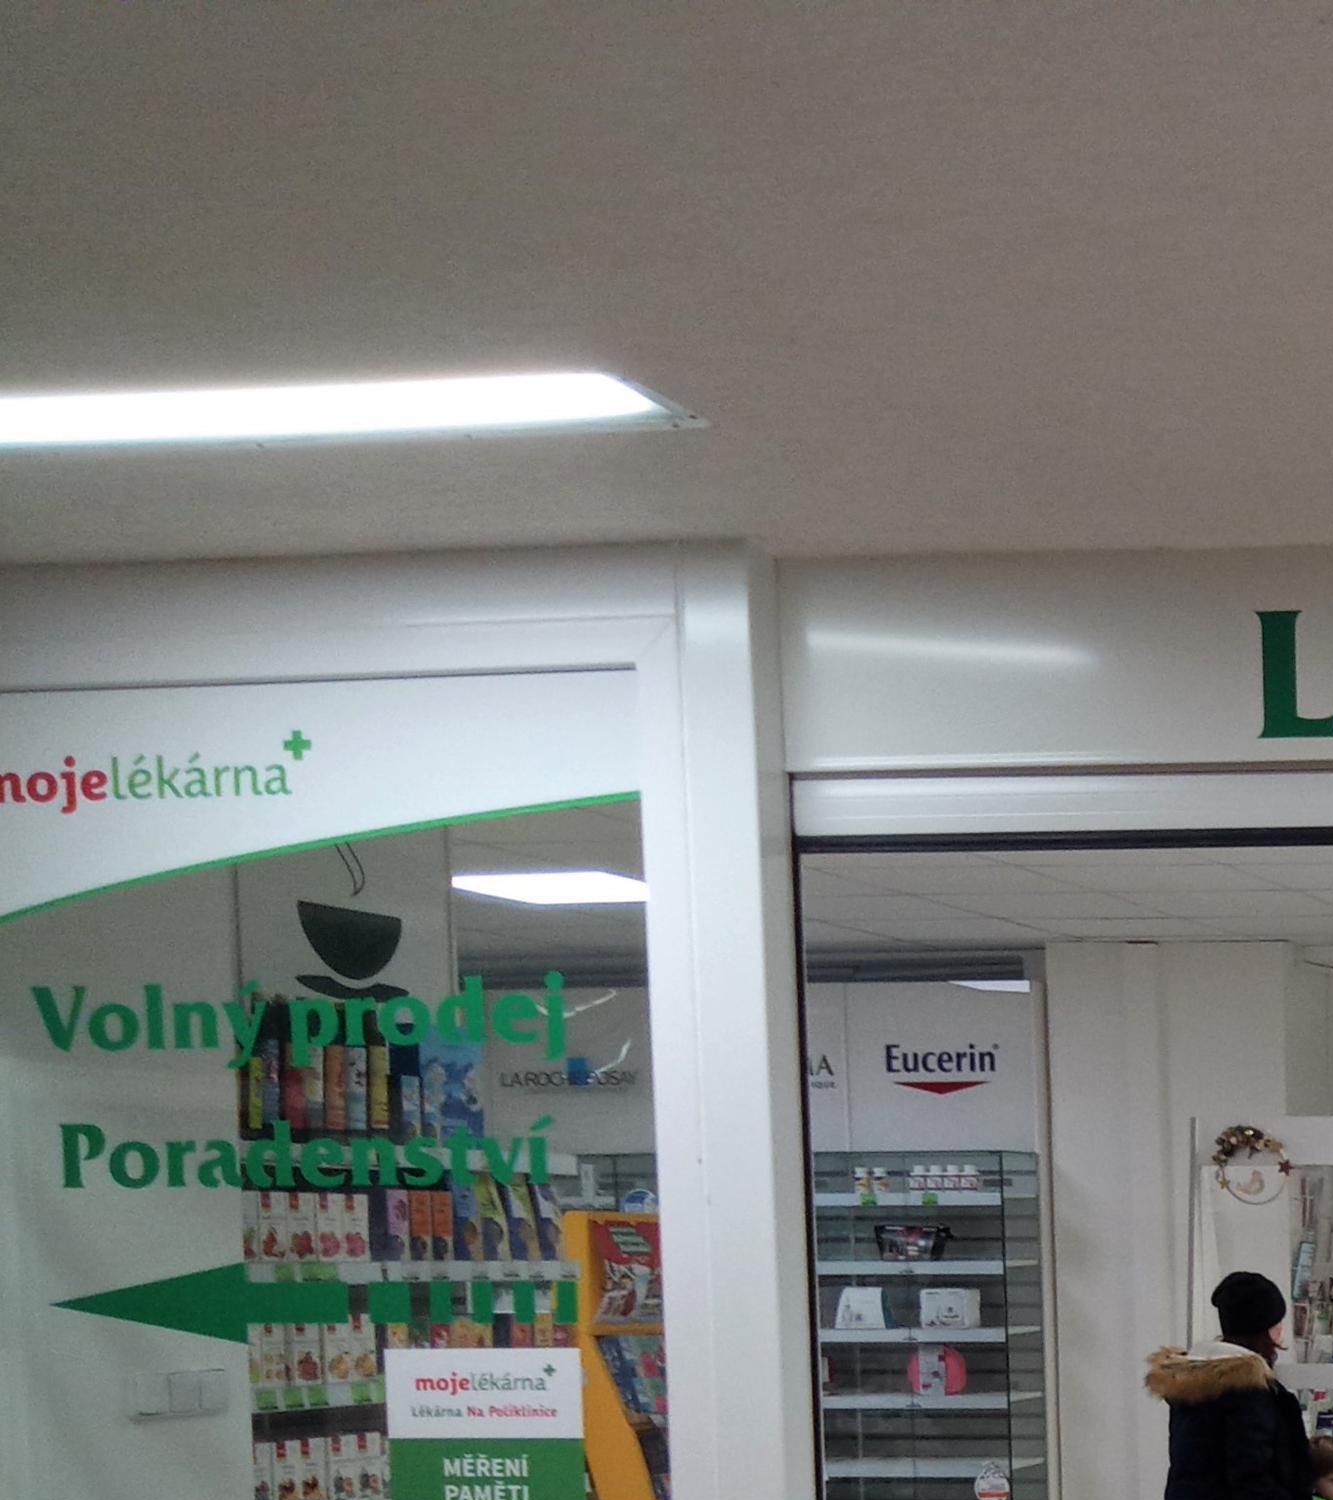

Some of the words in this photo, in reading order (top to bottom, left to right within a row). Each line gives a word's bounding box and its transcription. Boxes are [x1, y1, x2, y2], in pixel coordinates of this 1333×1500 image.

[31, 980, 267, 1068] Volný
[290, 970, 567, 1069] prodej
[885, 1043, 996, 1073] Eucerin
[58, 1115, 556, 1190] Poradenství
[415, 1371, 547, 1395] mojelékárna
[467, 1405, 484, 1418] Na
[443, 1454, 529, 1478] MĚŘENÍ
